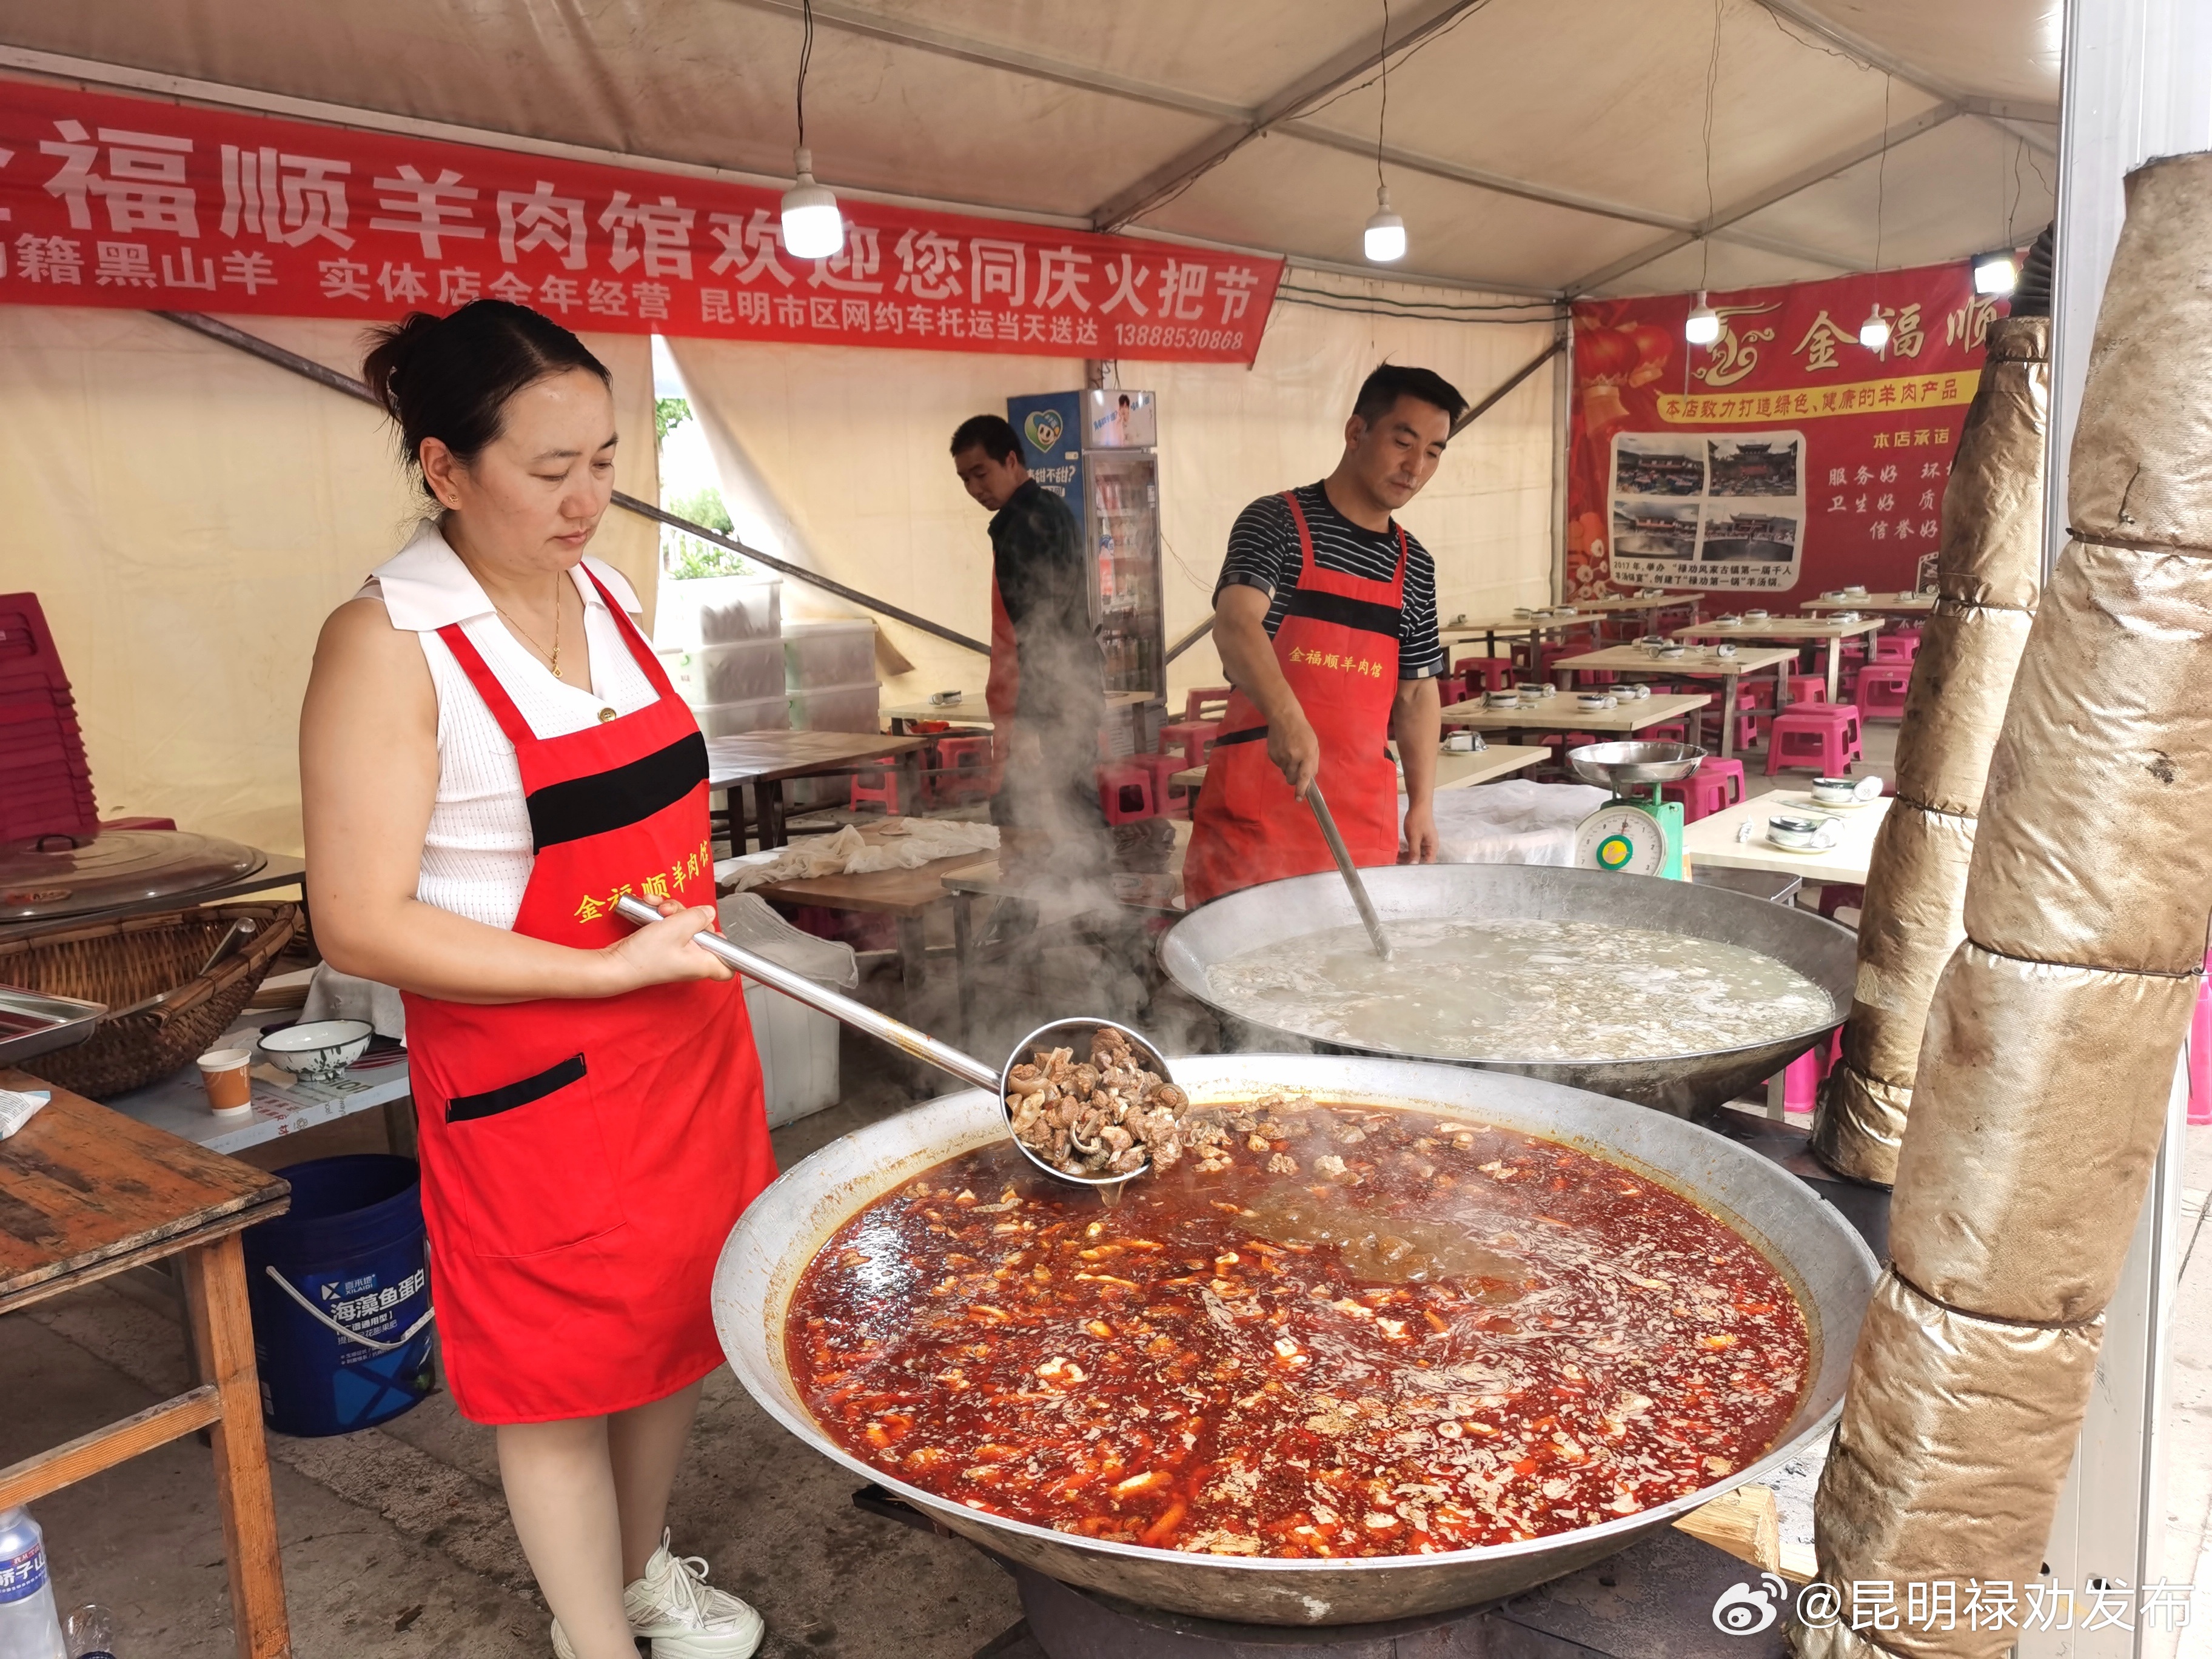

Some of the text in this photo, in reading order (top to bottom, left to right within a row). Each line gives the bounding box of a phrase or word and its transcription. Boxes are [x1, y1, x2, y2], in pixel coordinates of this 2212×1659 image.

[0, 119, 1259, 325] 福顺羊肉馆欢迎您同庆火把节
[0, 233, 279, 296] 籍黑山羊
[700, 287, 1099, 346] 昆明市区网约车托运当天送达
[1114, 323, 1244, 350] 13888530868
[1665, 378, 1959, 420] 本店致力打造绿色、健康的羊肉产品
[1873, 427, 1950, 449] 本店承诺
[1828, 464, 1899, 486] 服务好
[1827, 492, 1895, 513] 卫生好
[1869, 518, 1939, 540] 信誉好
[1288, 646, 1383, 678] 金福顺羊肉馆
